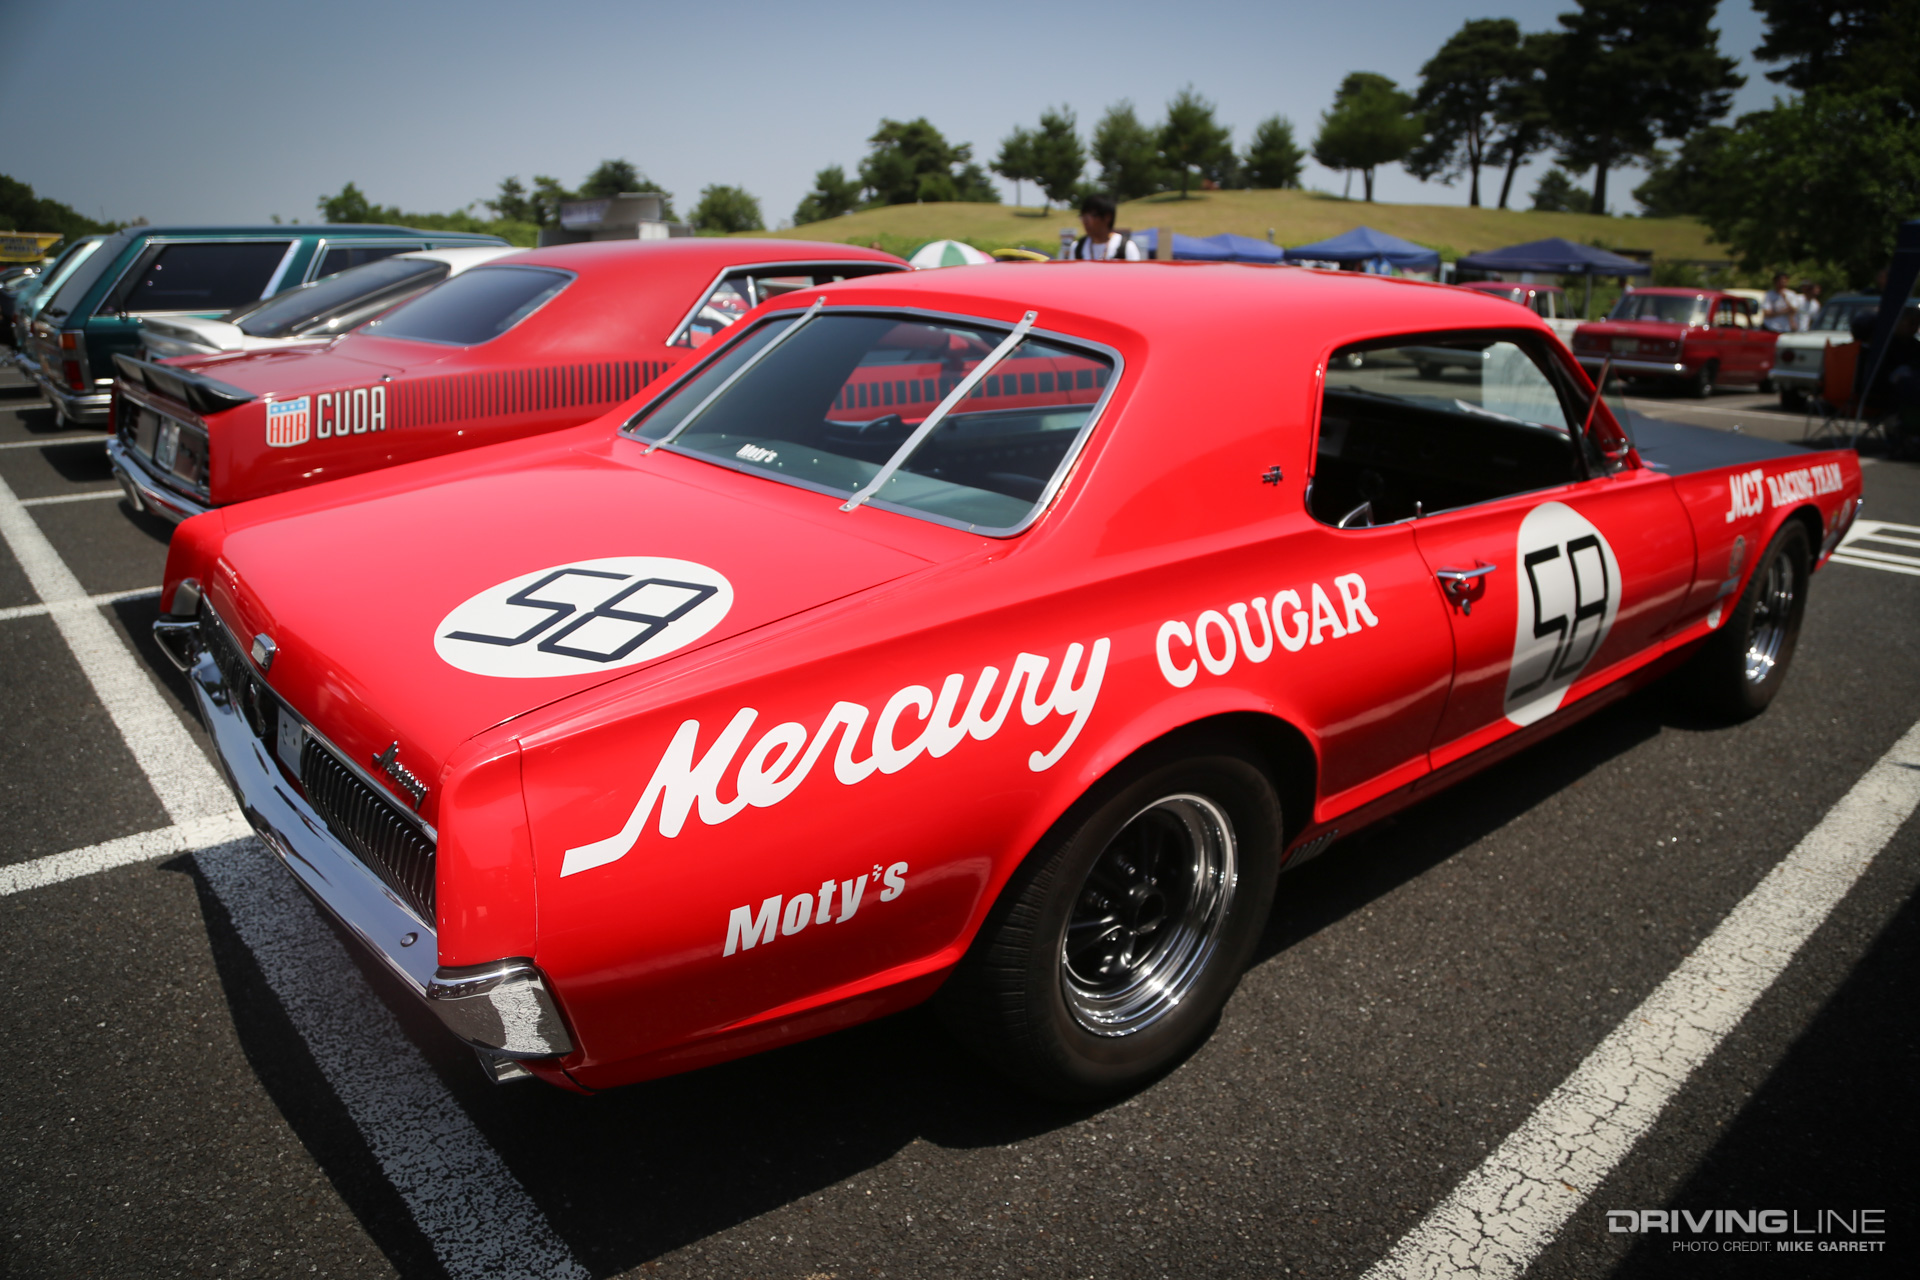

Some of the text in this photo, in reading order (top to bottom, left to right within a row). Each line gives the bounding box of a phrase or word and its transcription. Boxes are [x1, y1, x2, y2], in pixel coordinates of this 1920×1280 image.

[269, 385, 386, 444] AAR CUDA
[1766, 469, 1814, 507] RACING
[1811, 463, 1843, 495] TEAM
[443, 567, 718, 662] 58
[1507, 534, 1609, 702] 58
[560, 572, 1378, 877] Mercury COUGAR
[722, 860, 908, 957] Moty's
